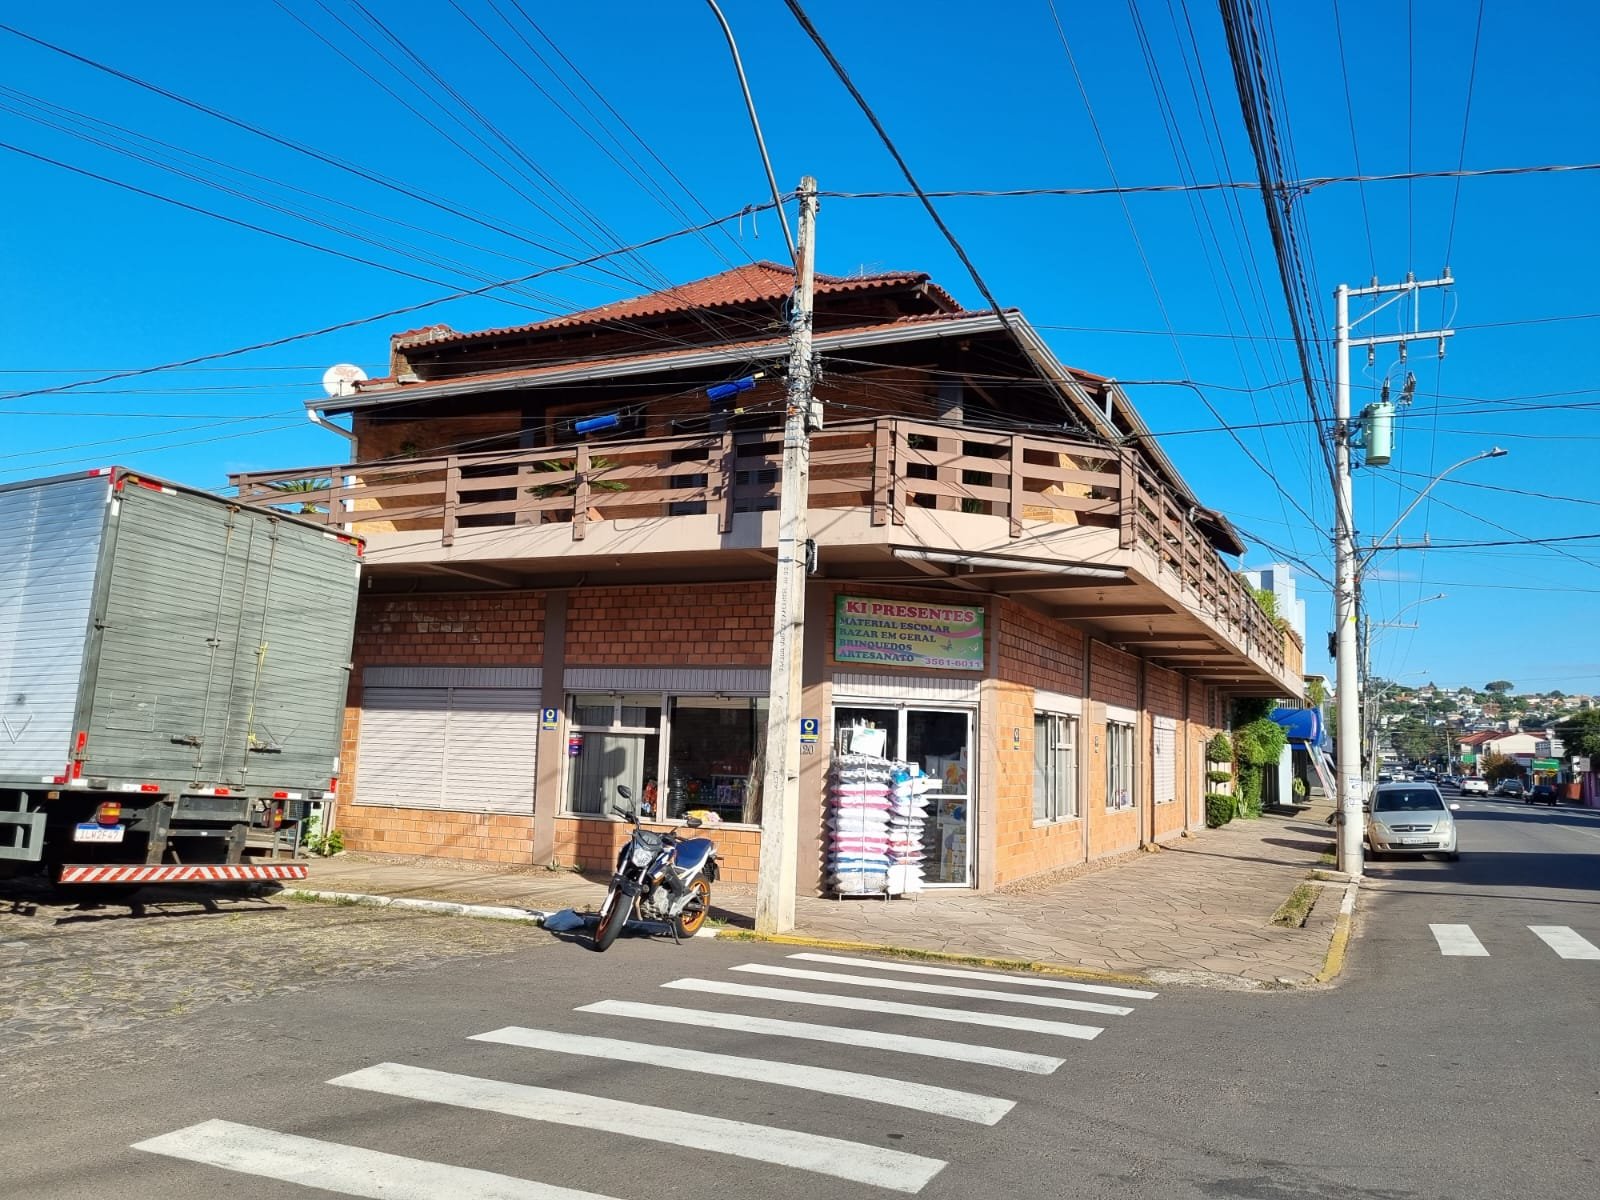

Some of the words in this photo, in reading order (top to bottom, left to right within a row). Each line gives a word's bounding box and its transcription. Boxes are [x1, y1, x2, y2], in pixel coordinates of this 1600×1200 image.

[847, 601, 867, 613] KI
[872, 603, 975, 622] PRESENTES
[840, 616, 898, 629] MATERIAL
[900, 622, 951, 633] ESCOLAR
[840, 628, 878, 638] BAZAR
[881, 631, 897, 640] EM
[899, 633, 937, 643] GERAL
[840, 639, 913, 651] BRINQUEDOS
[839, 650, 914, 662] ARTESANATO
